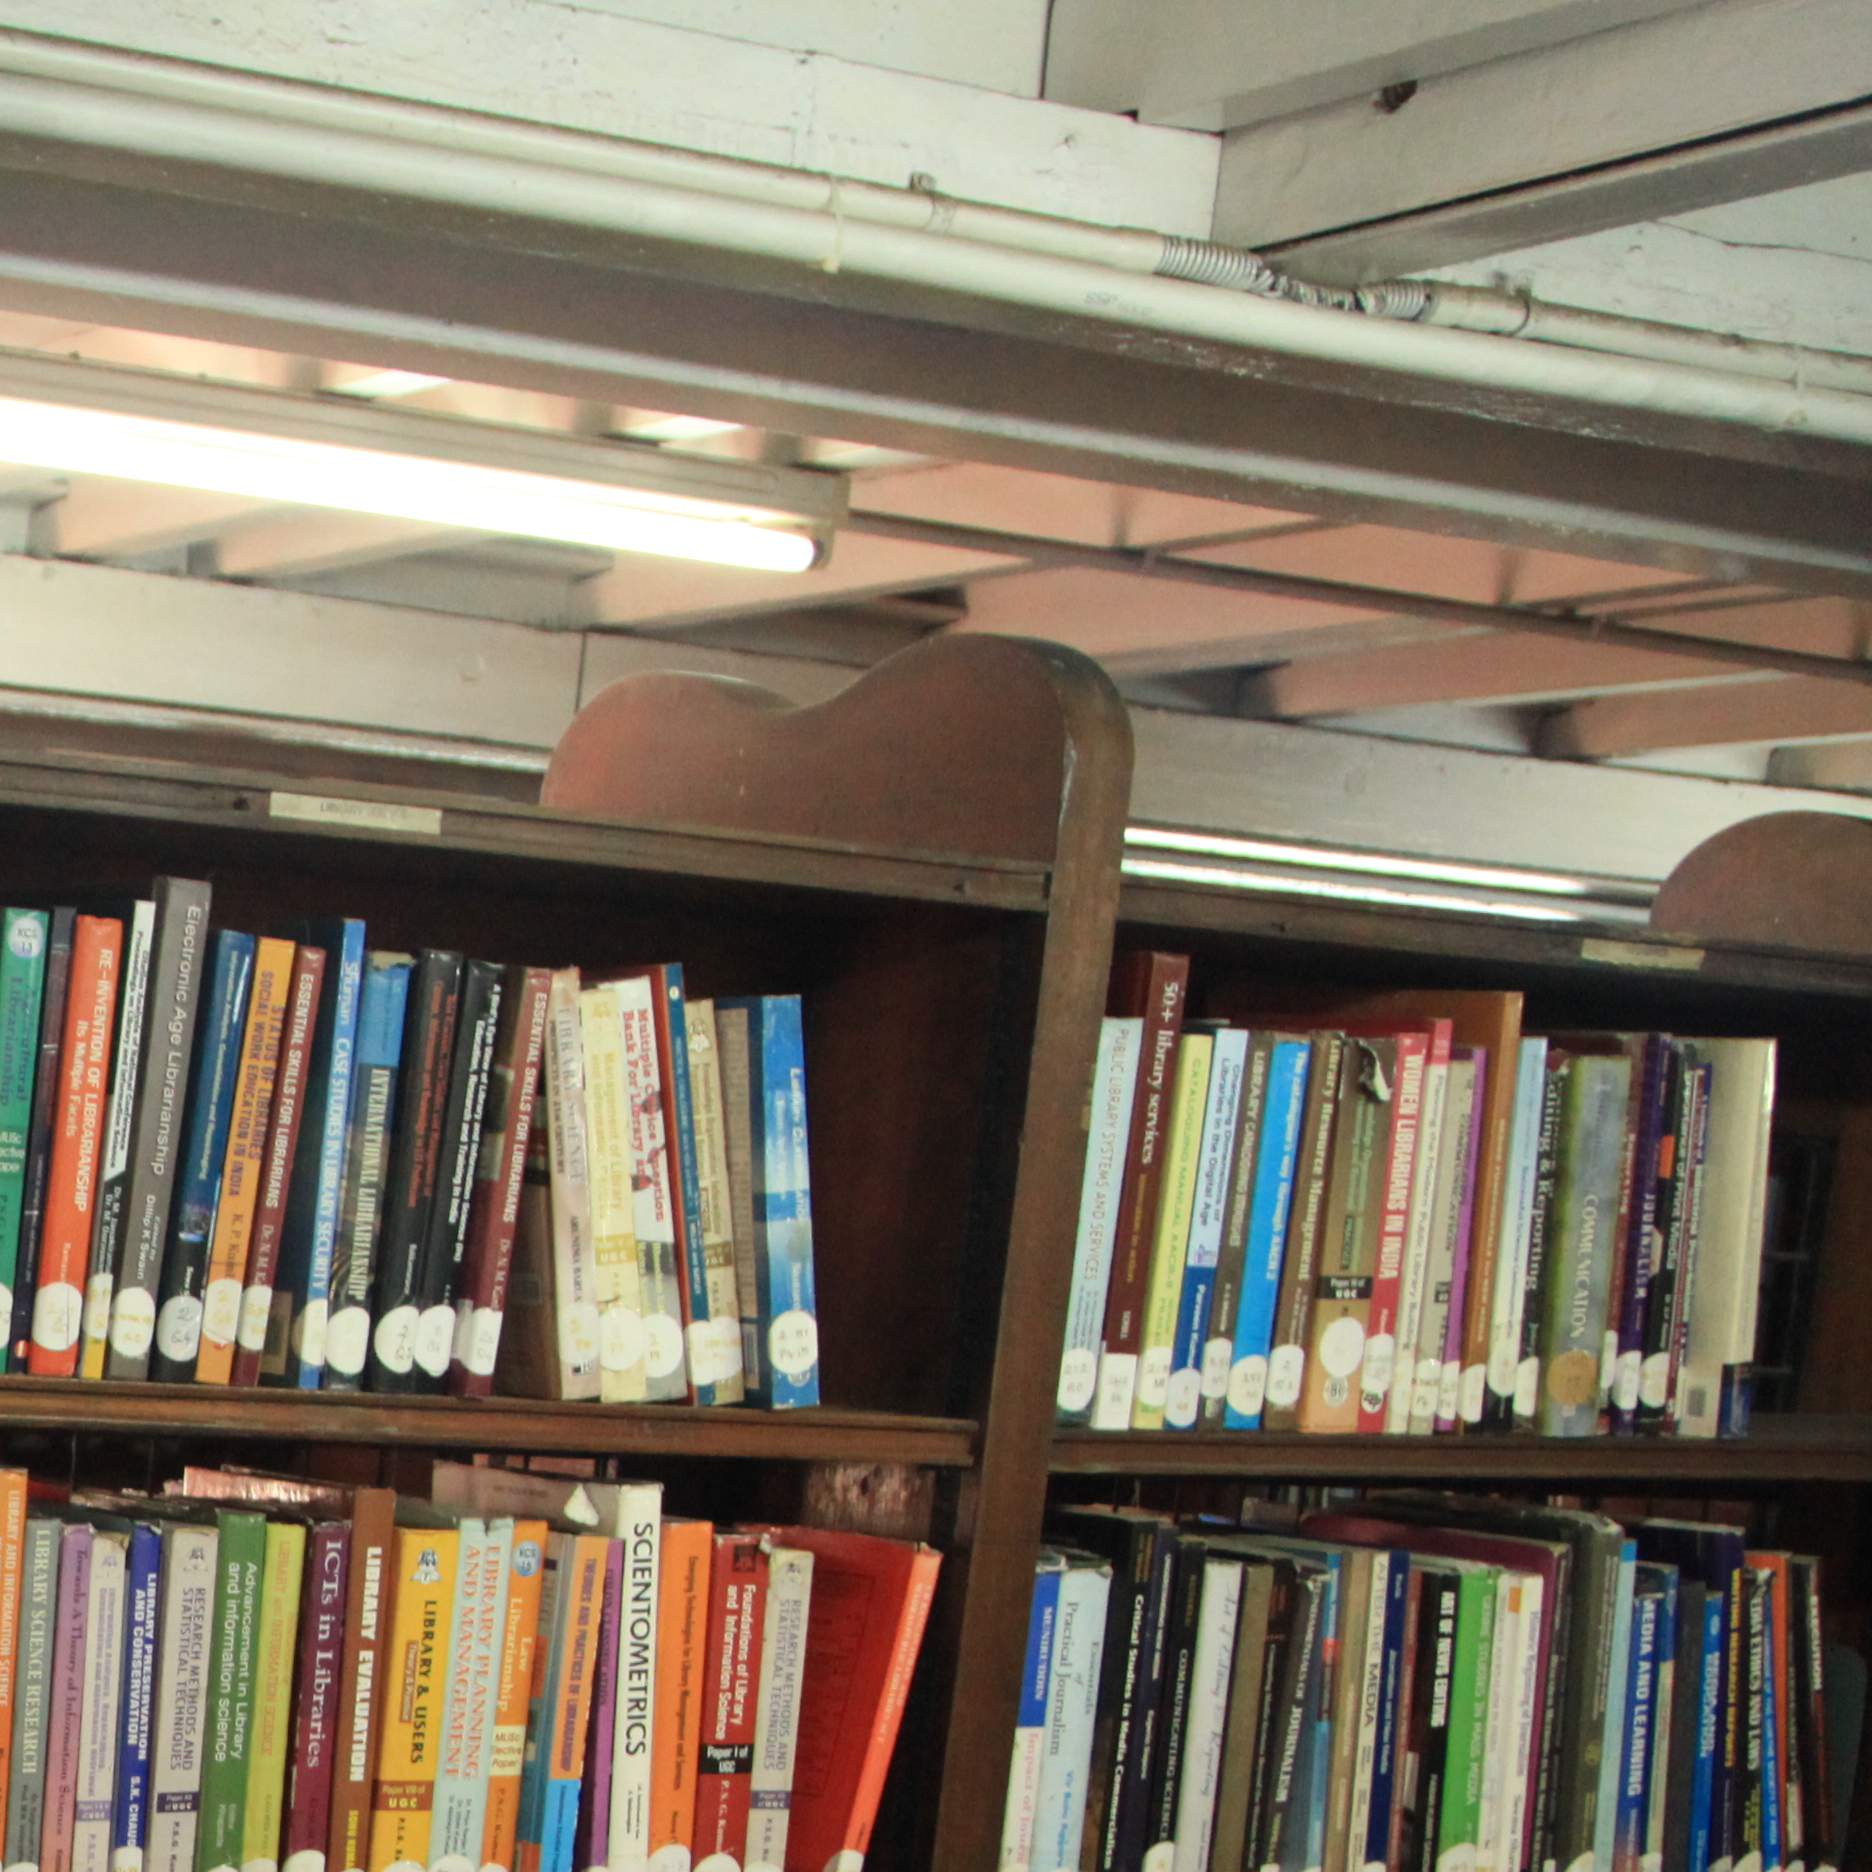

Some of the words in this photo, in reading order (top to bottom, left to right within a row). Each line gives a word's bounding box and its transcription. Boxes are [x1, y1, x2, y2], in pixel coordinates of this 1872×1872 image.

[172, 904, 203, 1004] Electronic
[87, 947, 115, 1063] RE-INVENTION
[167, 1004, 190, 1045] Age
[288, 972, 314, 1045] ESSENTIAL
[1157, 980, 1181, 1024] 50+
[84, 1066, 104, 1091] OF
[281, 1047, 303, 1093] SKILLS
[1148, 1029, 1175, 1090] library
[1398, 1054, 1425, 1119] WOMEN
[149, 1049, 184, 1178] Librarianship
[277, 1095, 296, 1120] FOR
[359, 1067, 389, 1181] INTERNATIONAL
[1138, 1091, 1167, 1166] services
[73, 1092, 101, 1213] LIBRARIANSHIP
[264, 1122, 292, 1210] LIBRARIANS
[1386, 1121, 1416, 1213] LIBRARIANS
[347, 1181, 378, 1299] LIBRARIANSHIP
[1378, 1236, 1402, 1280] INDIA
[1384, 1215, 1404, 1235] IN
[31, 1528, 53, 1606] LIBRARY
[143, 1572, 158, 1636] LIBRARY
[226, 1562, 241, 1597] and
[320, 1539, 344, 1606] ICTs
[360, 1545, 384, 1641] LIBRARY
[461, 1544, 482, 1598] AND
[477, 1544, 502, 1647] LIBRARY
[132, 1588, 146, 1624] AND
[239, 1560, 258, 1675] Advancement
[316, 1614, 337, 1642] in
[417, 1599, 438, 1681] LIBRARY
[625, 1521, 654, 1757] SCIENTOMETRICS
[1636, 1599, 1656, 1655] MEDIA
[27, 1607, 48, 1681] SCIENCE
[219, 1598, 238, 1695] information
[496, 1596, 524, 1713] Librarianship
[1633, 1660, 1652, 1702] AND
[126, 1626, 144, 1746] CONSERVATION
[136, 1636, 154, 1761] PRESERVATION
[237, 1677, 251, 1700] in
[304, 1649, 333, 1770] Libraries
[349, 1649, 375, 1783] EVALUATION
[416, 1684, 431, 1701] &
[444, 1600, 476, 1779] MANAGEMENT
[465, 1653, 492, 1780] PLANNING
[22, 1683, 44, 1775] RESEARCH
[214, 1697, 231, 1763] science
[234, 1701, 249, 1760] Library
[410, 1705, 429, 1766] USERS
[1627, 1704, 1649, 1798] LEARNING
[388, 1798, 418, 1808] UGC
